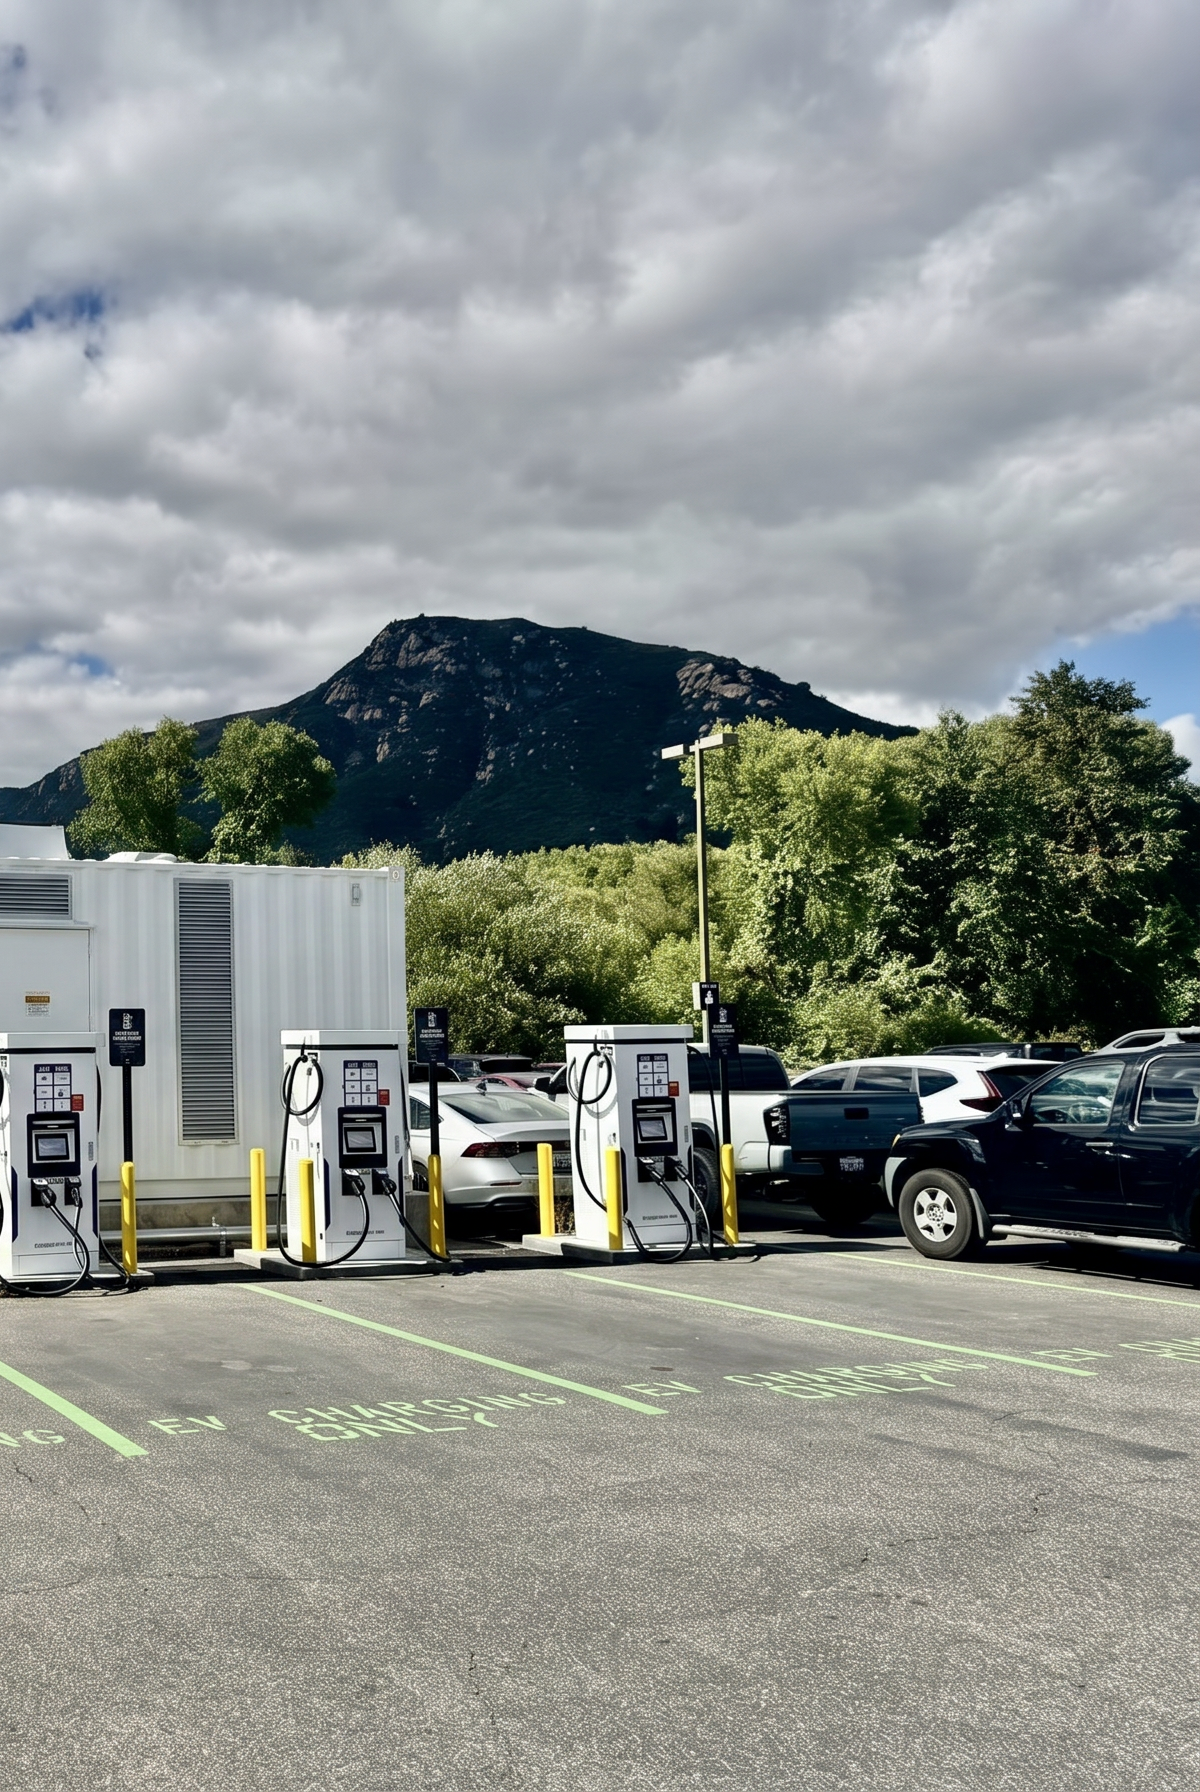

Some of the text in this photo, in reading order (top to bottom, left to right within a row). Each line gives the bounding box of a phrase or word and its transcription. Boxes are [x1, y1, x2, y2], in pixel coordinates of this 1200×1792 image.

[1031, 1348, 1114, 1362] EV
[621, 1359, 988, 1397] EV CHARGING
[767, 1374, 956, 1399] ONLY
[147, 1392, 566, 1435] EV CHARGING
[295, 1412, 500, 1441] ONLY
